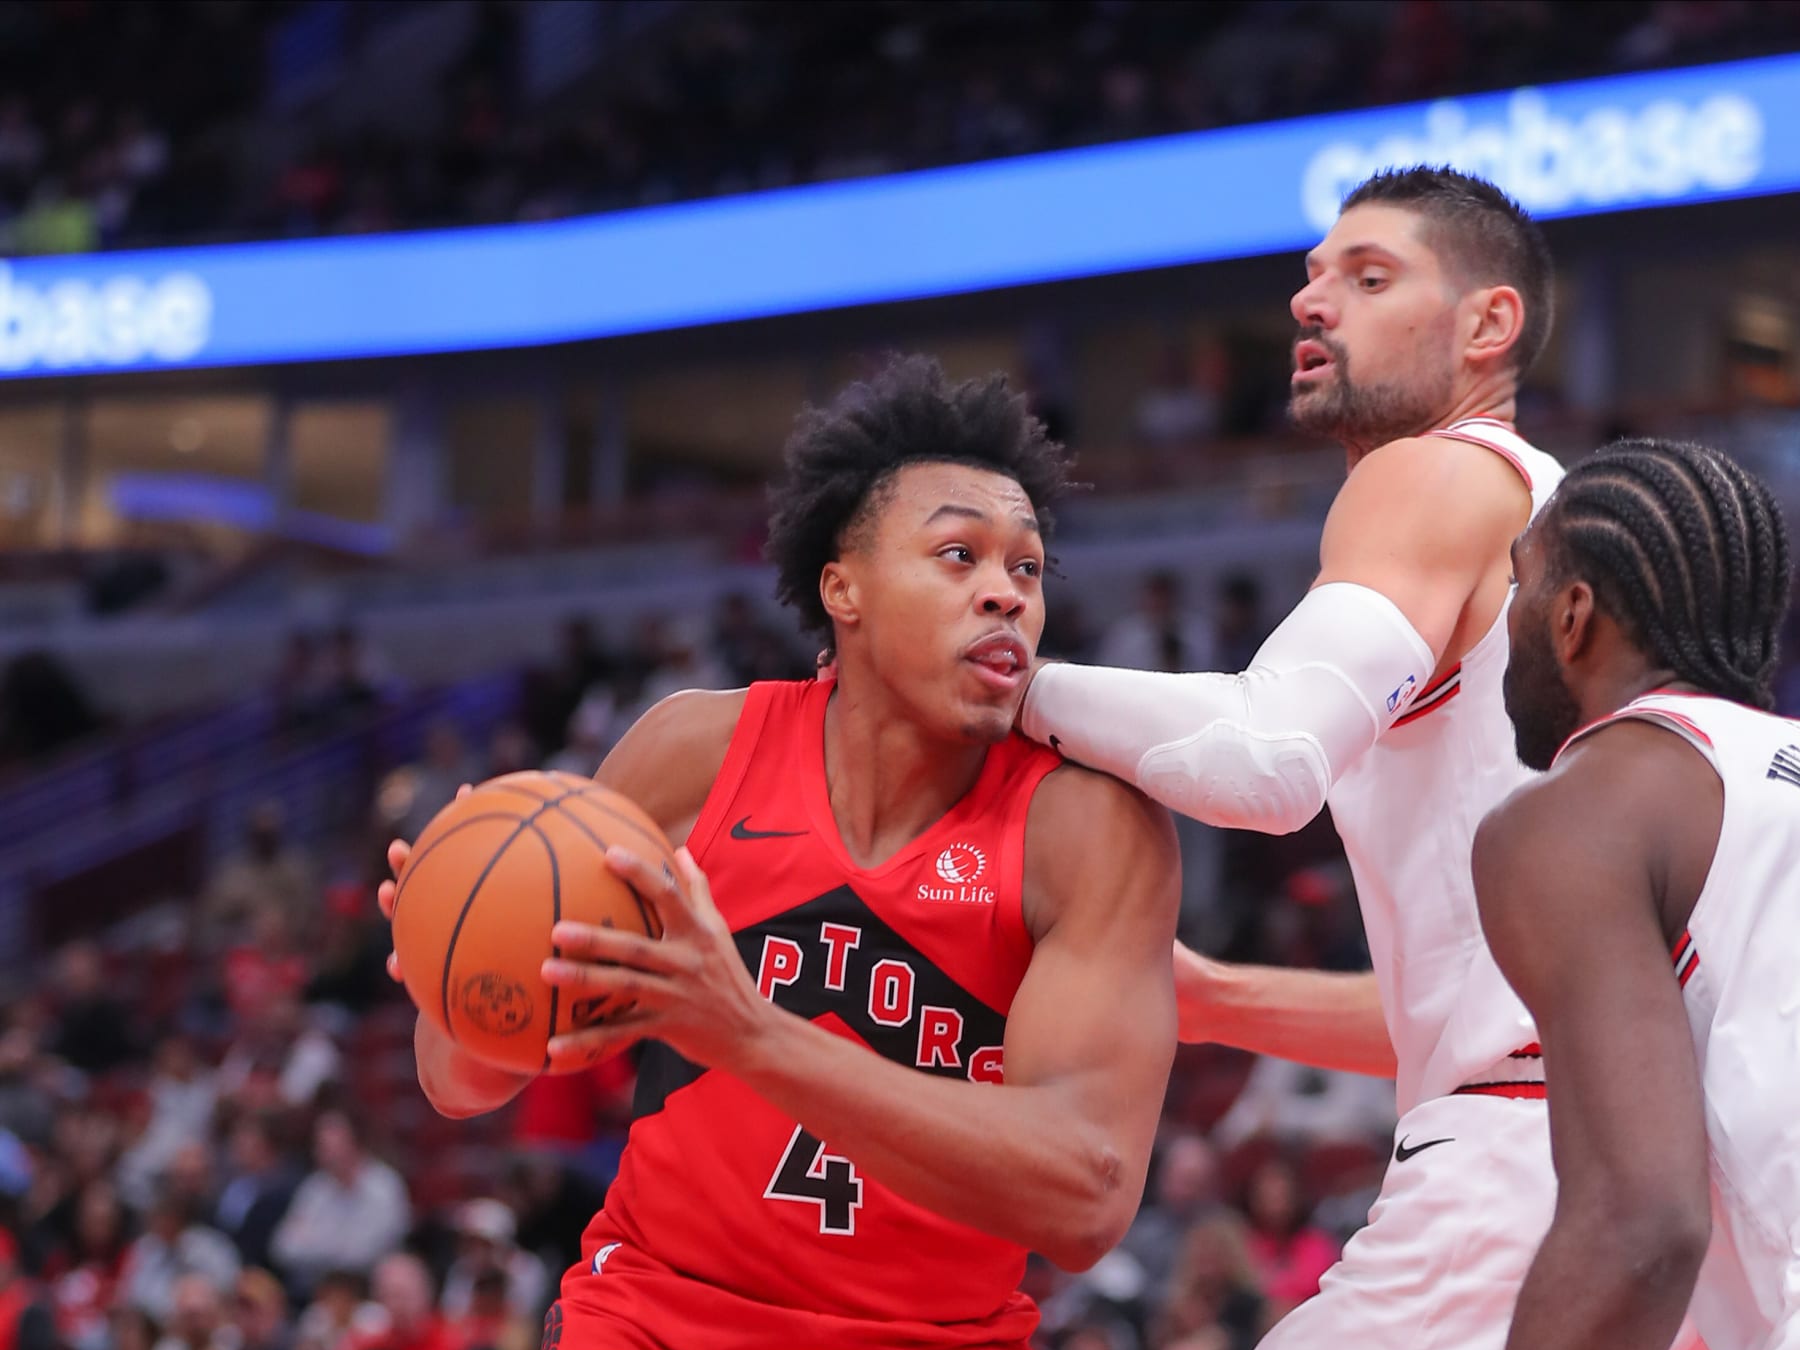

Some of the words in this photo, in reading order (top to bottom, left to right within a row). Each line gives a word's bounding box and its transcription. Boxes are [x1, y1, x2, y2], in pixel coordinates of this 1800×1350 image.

[917, 884, 955, 901] Sun
[959, 886, 995, 904] Life
[763, 1124, 863, 1236] 4
